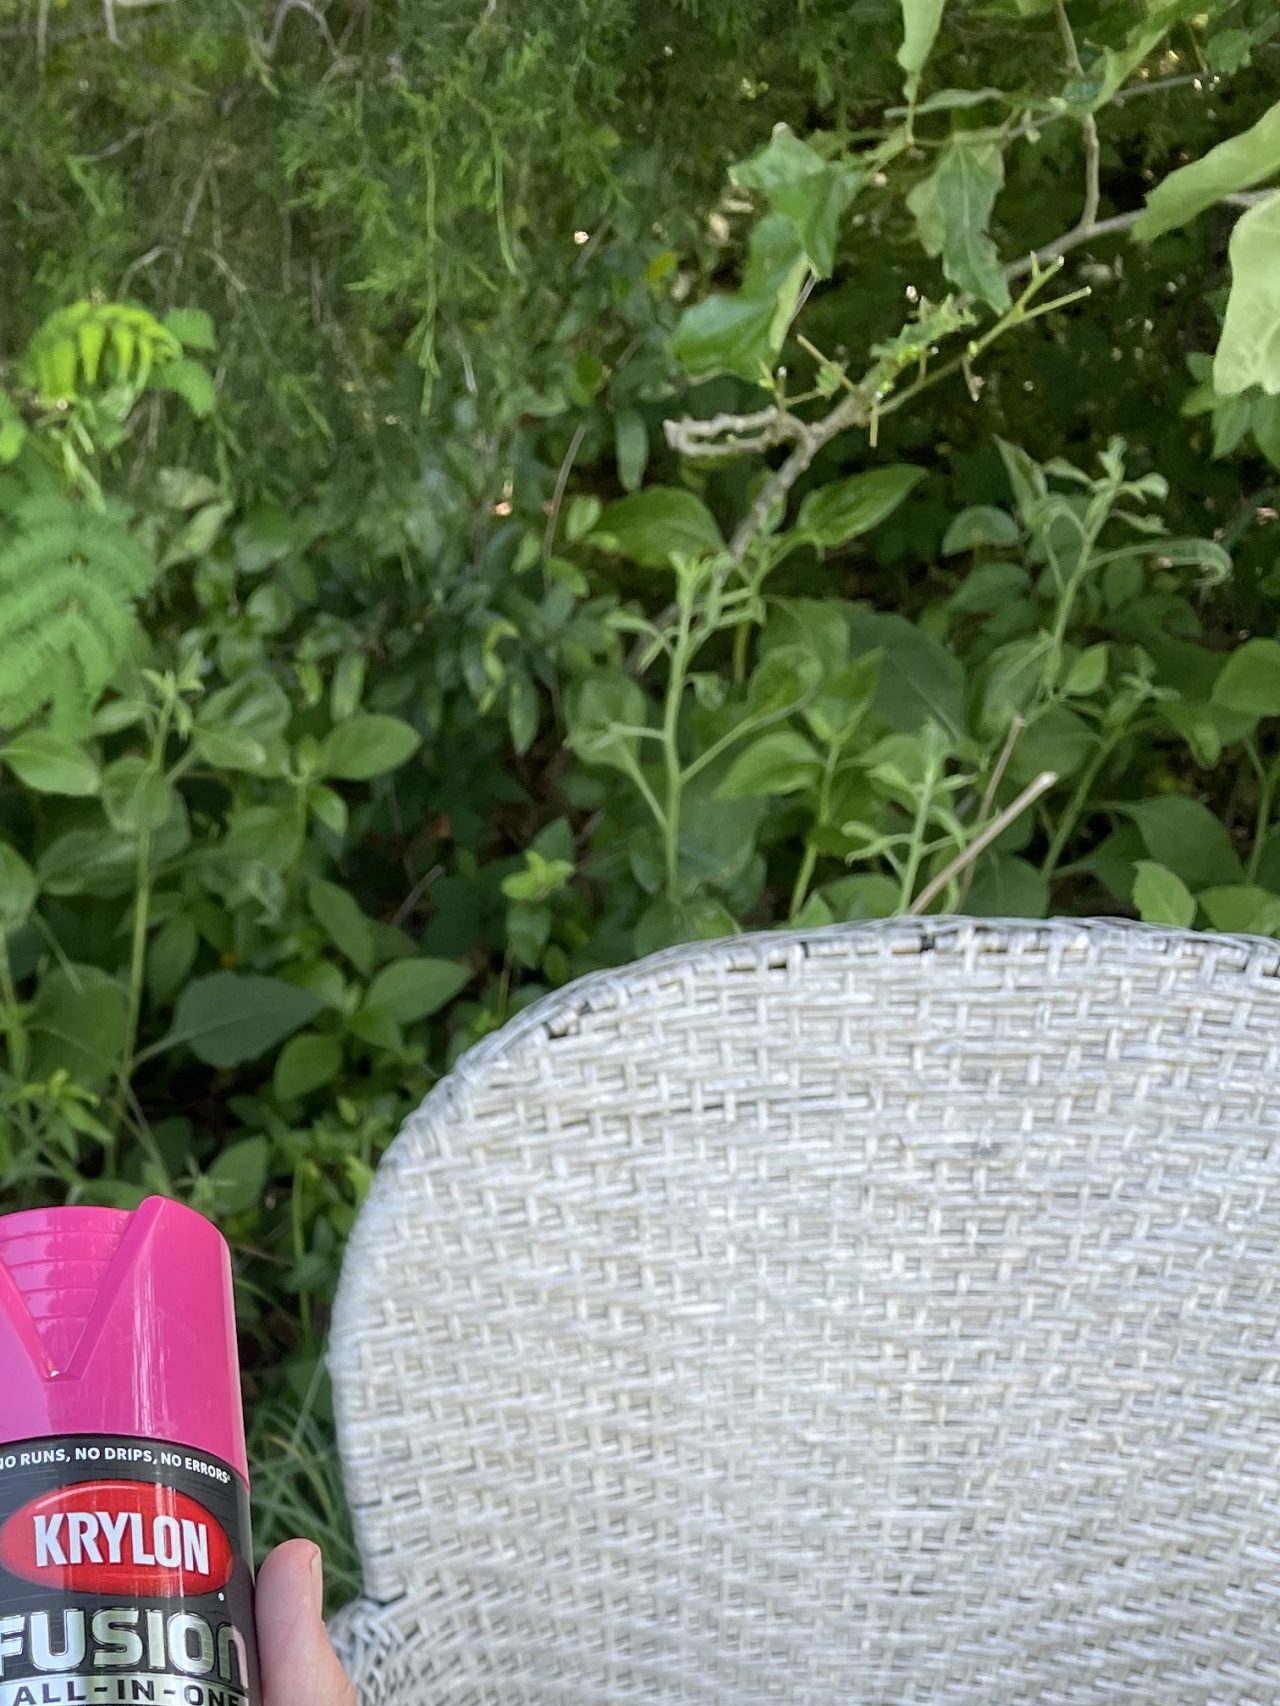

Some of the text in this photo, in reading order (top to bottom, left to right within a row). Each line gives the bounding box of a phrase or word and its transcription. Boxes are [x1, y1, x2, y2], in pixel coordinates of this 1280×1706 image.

[21, 1448, 71, 1466] RUNS,
[76, 1447, 100, 1461] NO
[105, 1447, 158, 1465] DRIPS,
[161, 1452, 182, 1467] NO
[32, 1511, 210, 1576] KRYLON
